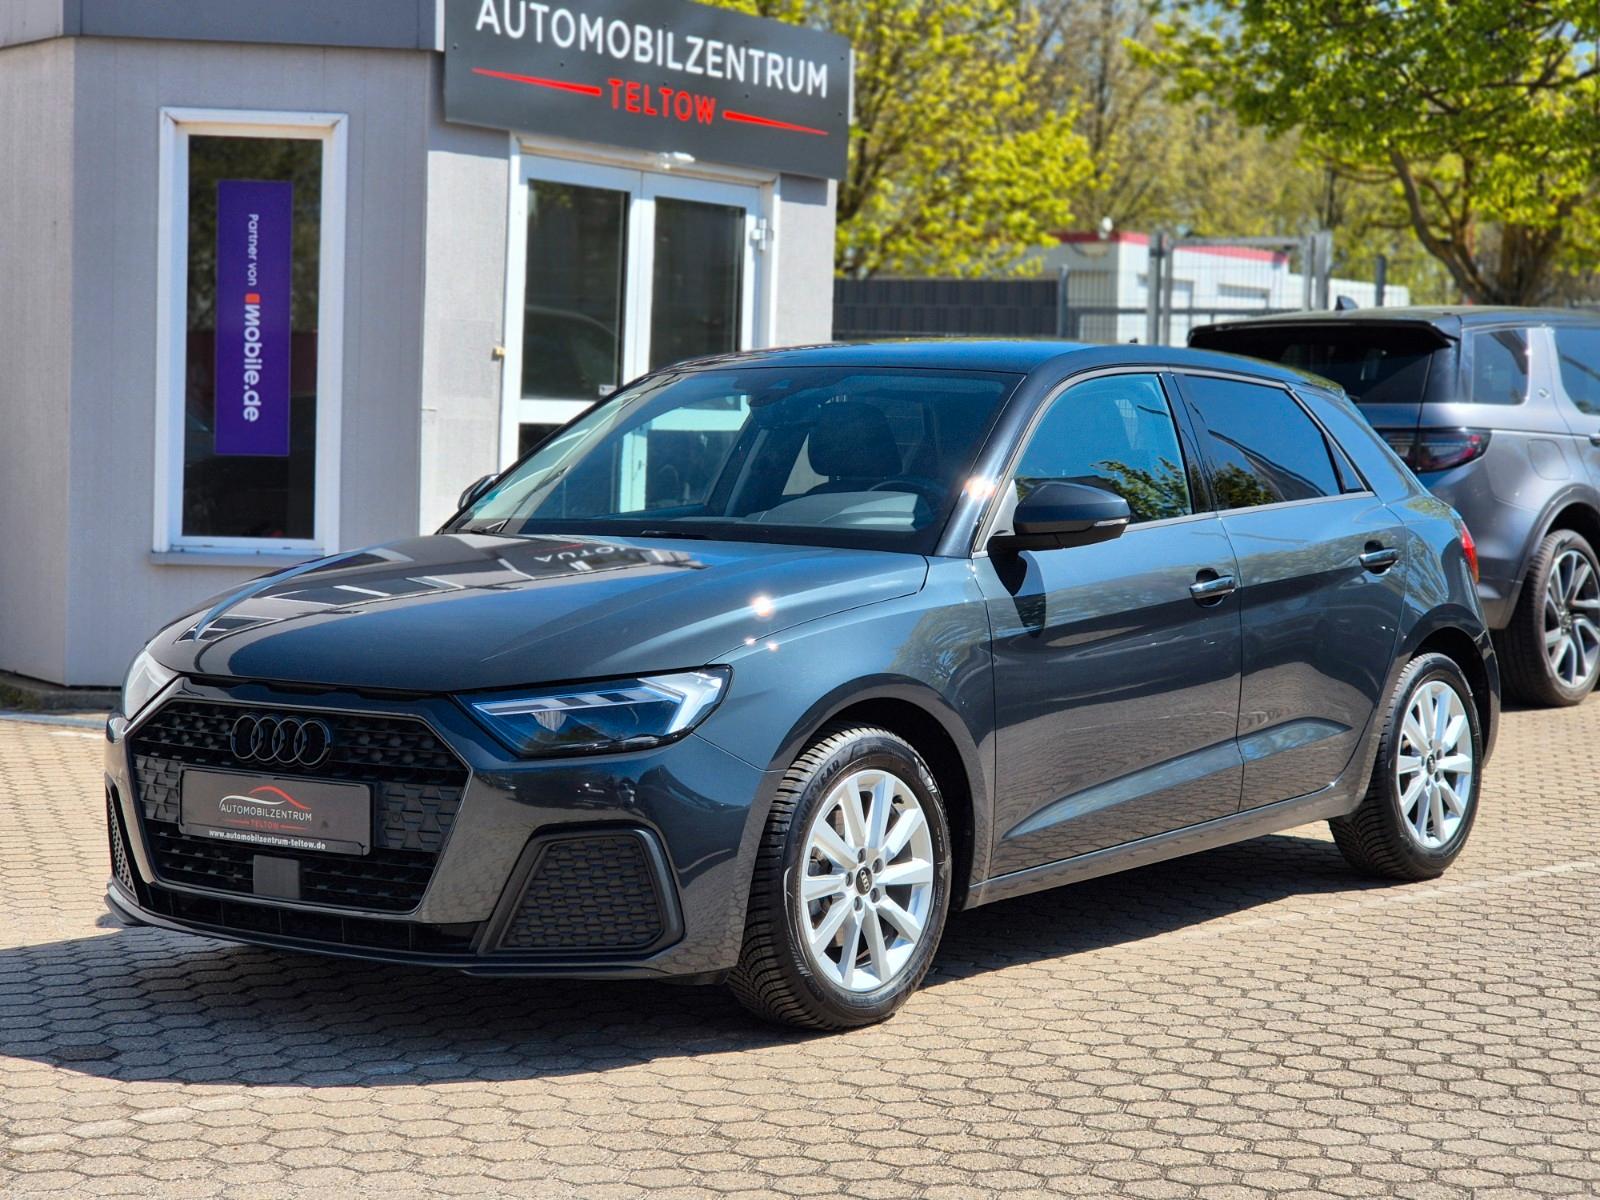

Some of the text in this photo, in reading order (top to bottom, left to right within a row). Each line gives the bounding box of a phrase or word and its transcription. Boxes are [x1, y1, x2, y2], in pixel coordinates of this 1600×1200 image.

[476, 0, 828, 98] AUTOMOBILZENTRUM
[608, 78, 716, 125] TELTOW
[248, 213, 259, 286] Partner von
[243, 304, 262, 422] mobile.de
[220, 803, 312, 822] AUTOMOBILZENTRUM
[249, 818, 280, 831] TELTOW
[208, 829, 326, 850] www.automobilzentrum-teltow.de
